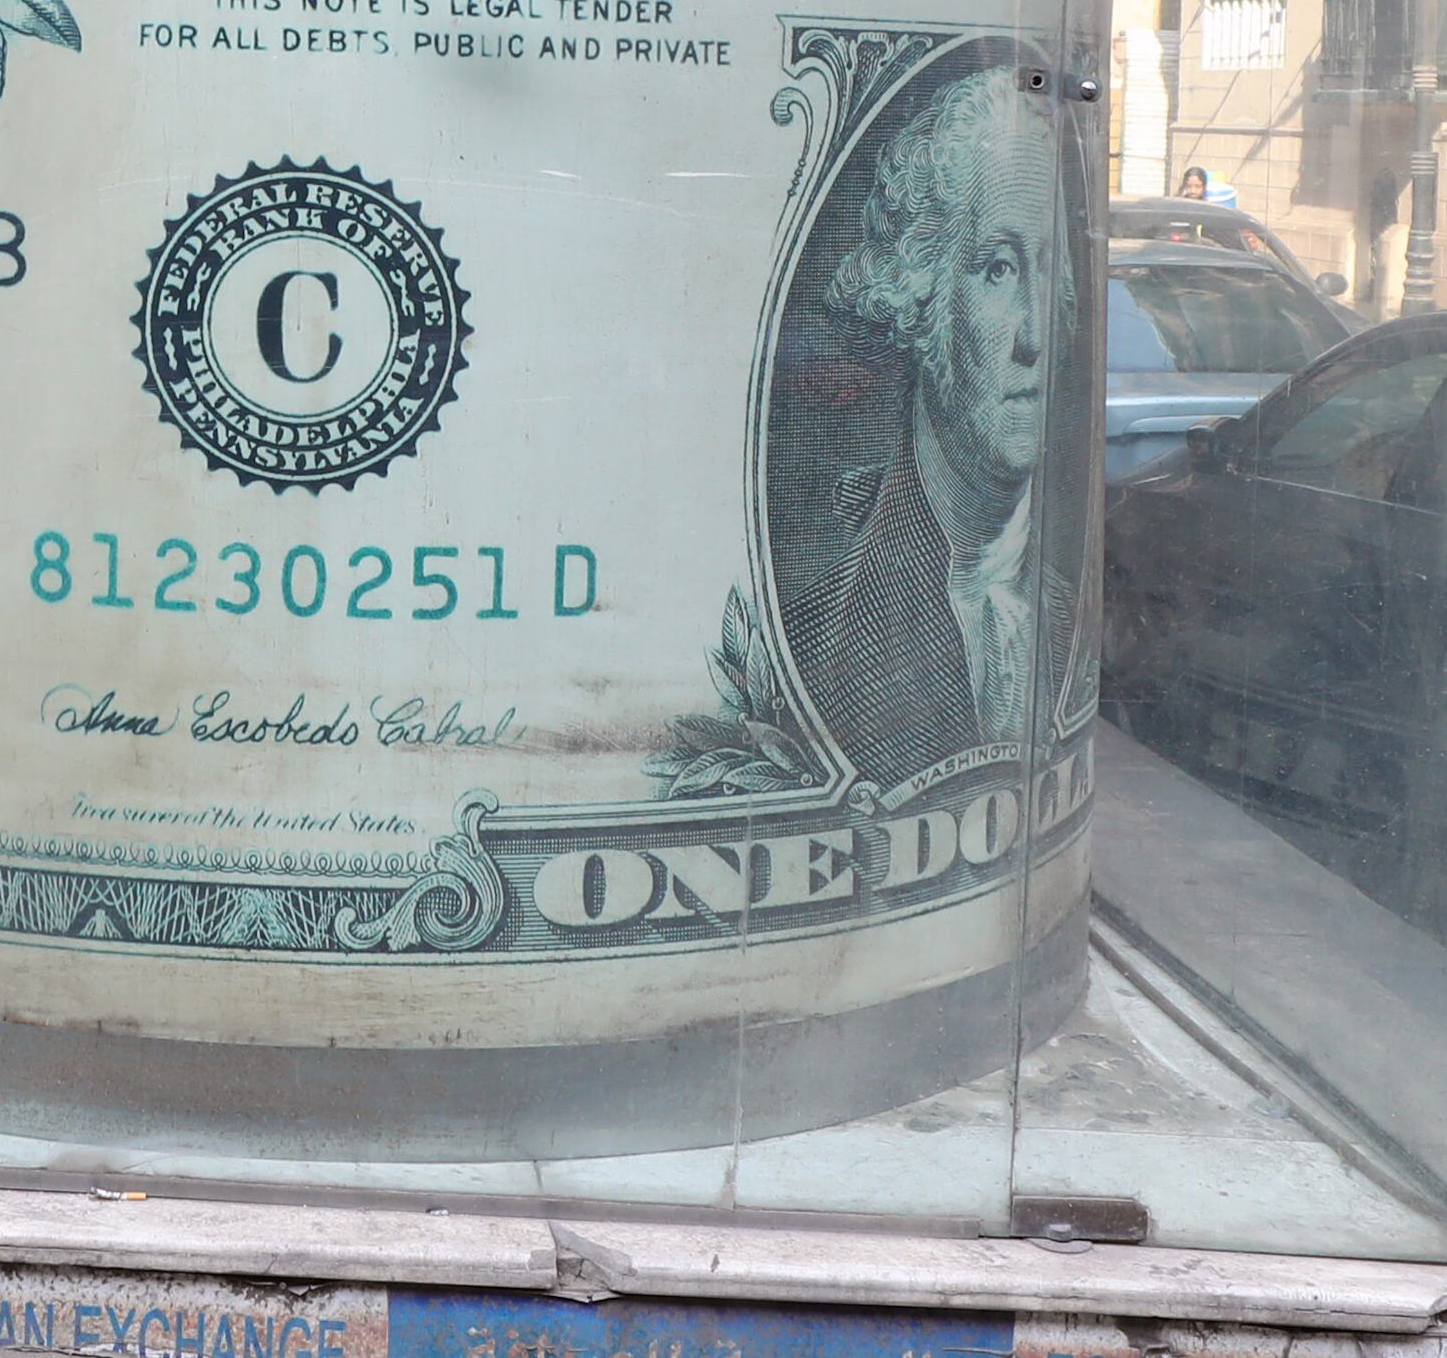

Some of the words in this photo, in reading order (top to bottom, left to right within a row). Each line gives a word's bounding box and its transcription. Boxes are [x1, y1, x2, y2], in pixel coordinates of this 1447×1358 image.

[139, 23, 198, 49] FOR
[212, 26, 267, 51] ALL
[415, 32, 524, 60] PUBLIC
[539, 35, 601, 62] AND
[616, 38, 732, 66] PRIVATE
[157, 183, 297, 317] FEDERAL
[305, 183, 445, 327] RESERVE
[209, 207, 328, 261] BANK
[336, 218, 393, 259] OF
[257, 269, 344, 384] C
[169, 377, 425, 471] PENNSYLVANIA
[181, 326, 421, 446] PHILADELPHIA
[29, 529, 519, 621] 81230251
[554, 542, 601, 616] D
[191, 690, 359, 746] Escobedo
[532, 828, 855, 927] ONE
